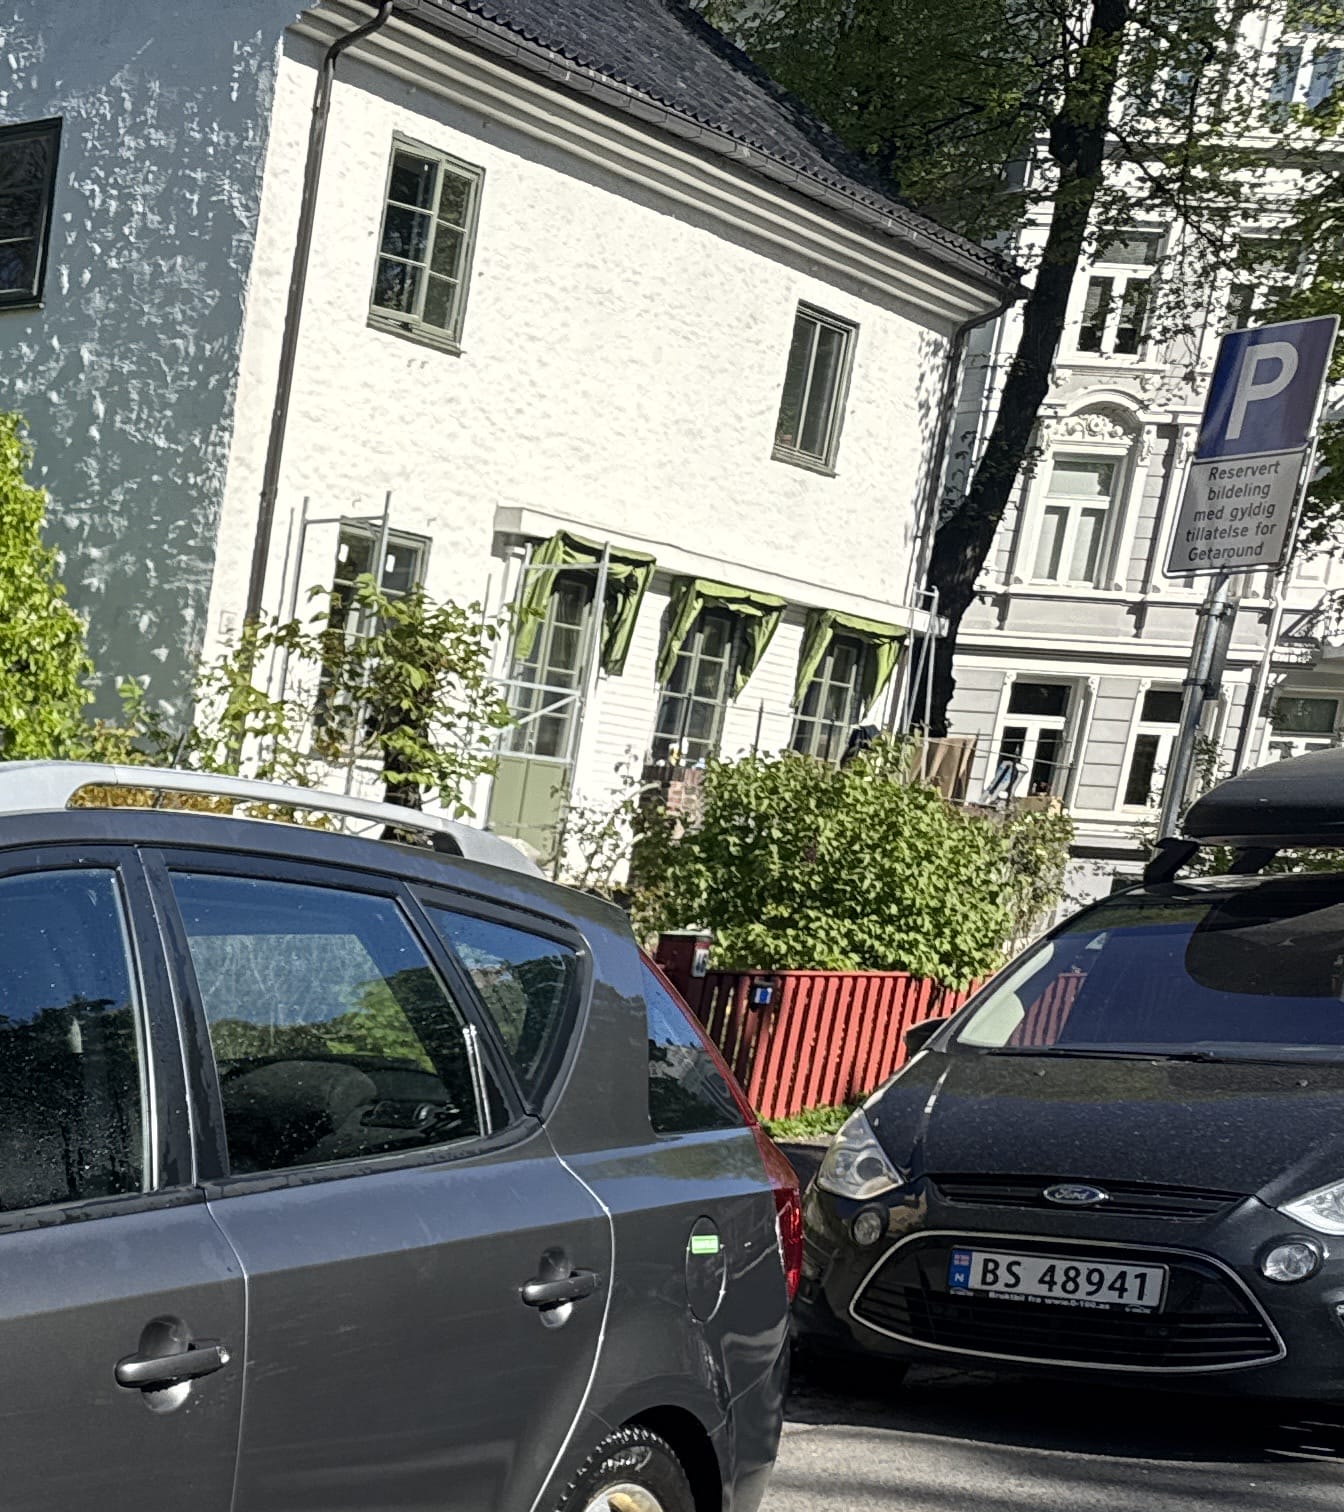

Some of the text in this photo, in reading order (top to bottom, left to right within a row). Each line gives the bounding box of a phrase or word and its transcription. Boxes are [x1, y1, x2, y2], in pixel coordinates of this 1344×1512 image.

[1225, 341, 1299, 440] P
[1208, 461, 1280, 481] Reservert
[1207, 483, 1271, 500] bildeling
[1193, 501, 1276, 522] med gyldig
[1185, 521, 1277, 543] tillatelse for
[1188, 541, 1265, 561] Getaround
[954, 1273, 965, 1283] N
[980, 1257, 1148, 1302] BS 48941
